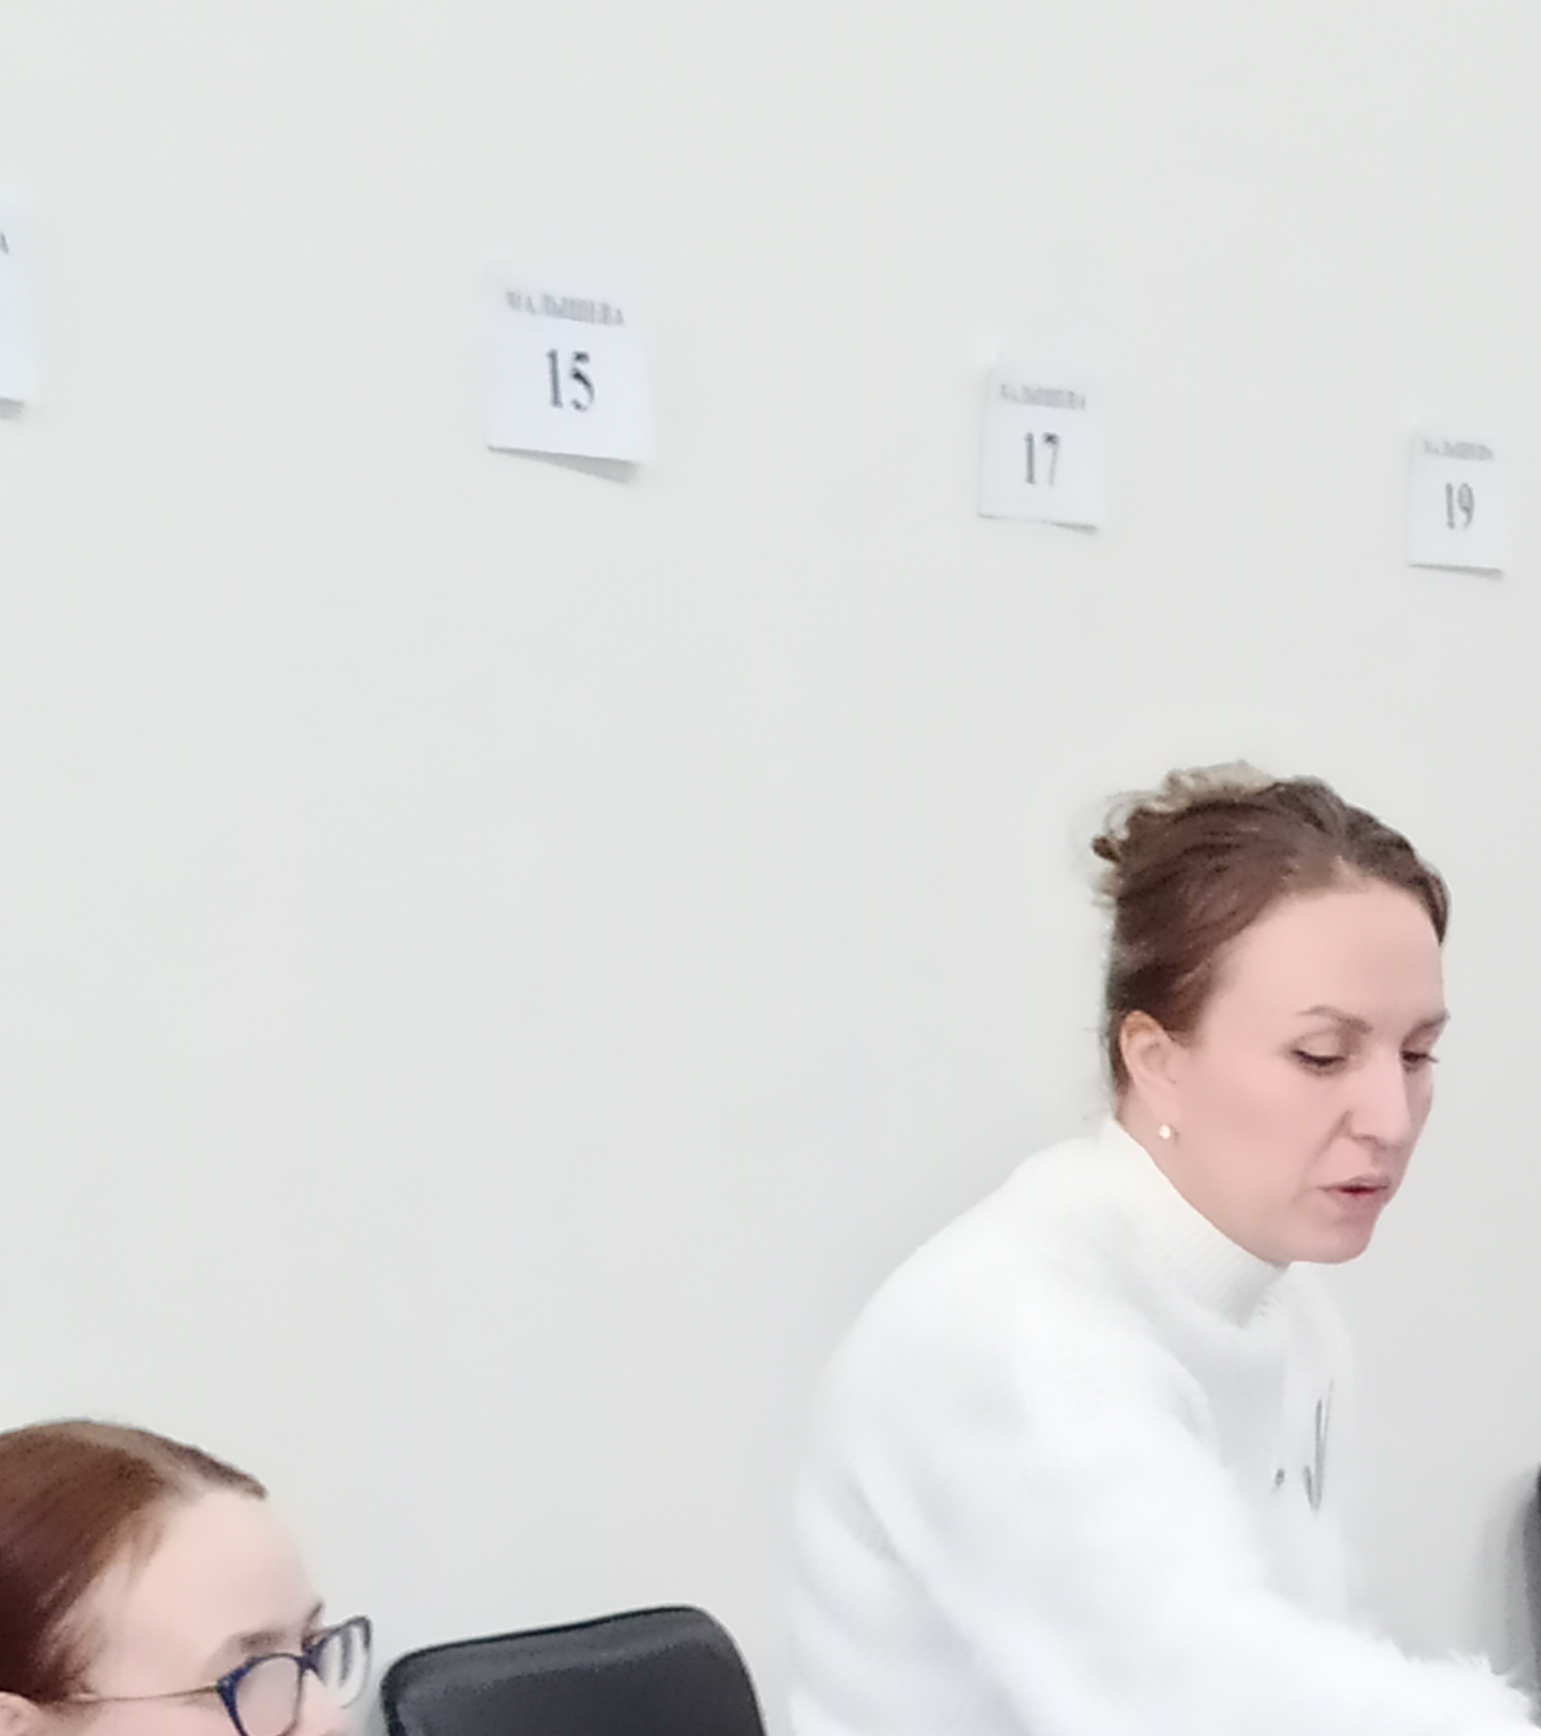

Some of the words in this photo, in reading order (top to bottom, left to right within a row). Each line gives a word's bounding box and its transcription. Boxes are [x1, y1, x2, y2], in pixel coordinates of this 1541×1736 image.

[546, 349, 595, 412] 15
[1024, 431, 1061, 486] 17
[1445, 483, 1475, 530] 19
